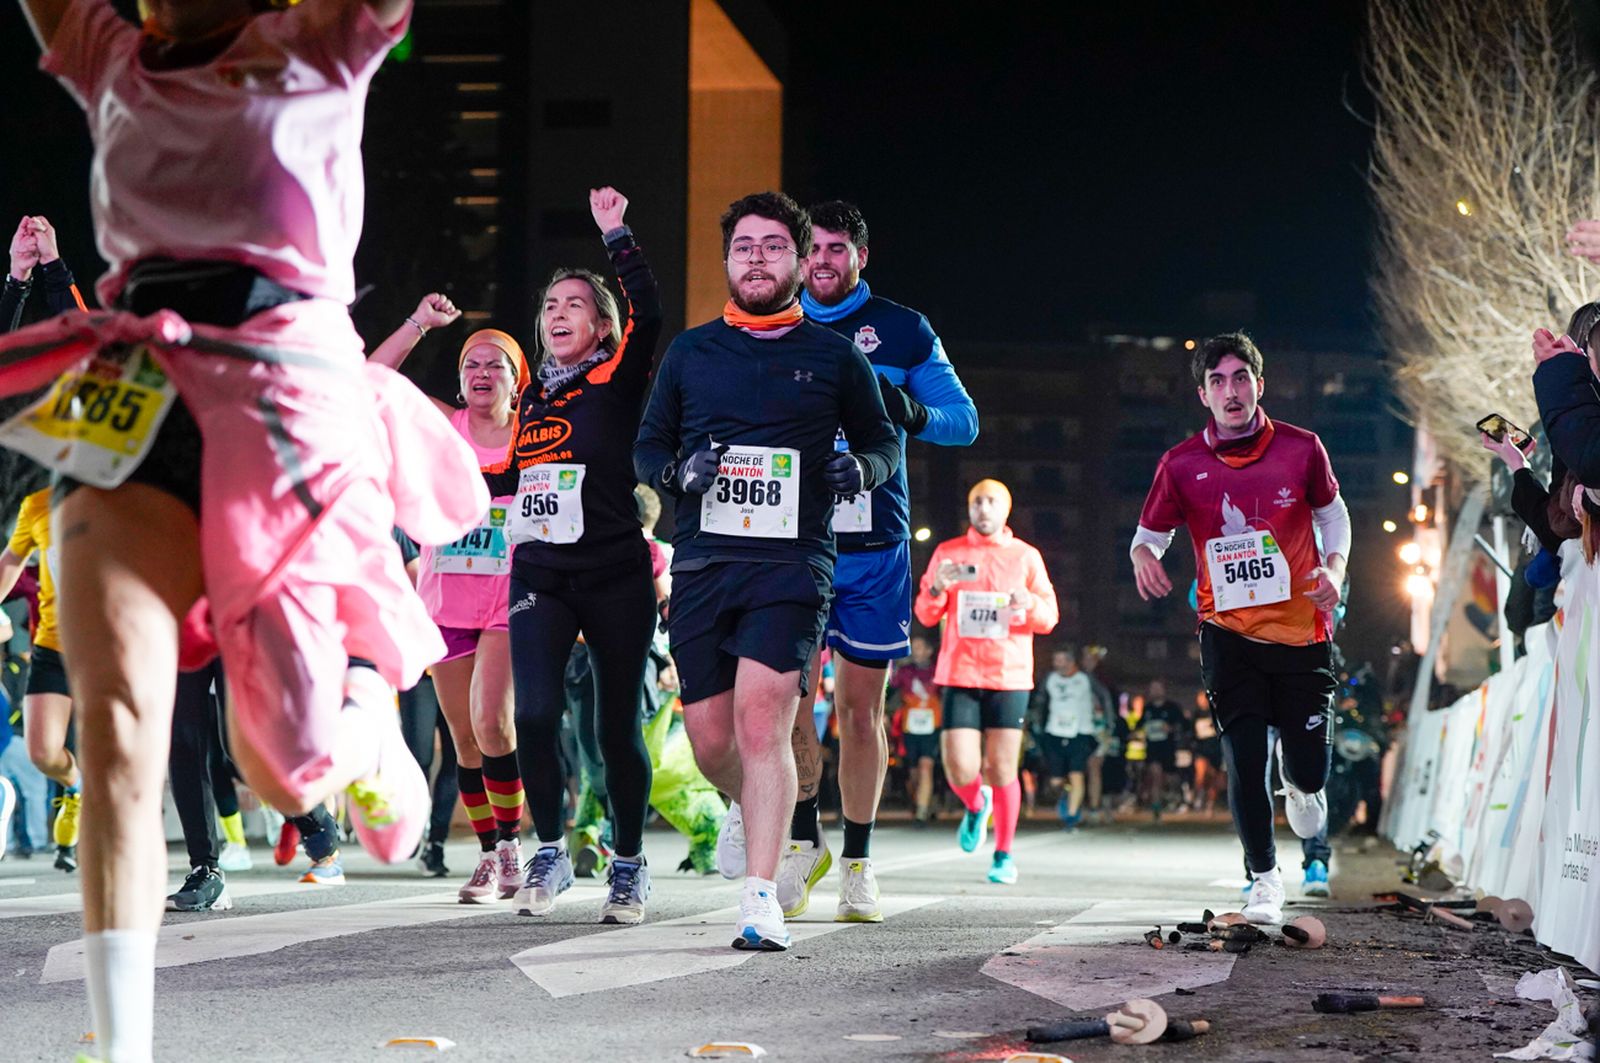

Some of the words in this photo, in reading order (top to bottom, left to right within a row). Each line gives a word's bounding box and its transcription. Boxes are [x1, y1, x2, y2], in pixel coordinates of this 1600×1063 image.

[518, 425, 562, 447] GALBIS
[720, 455, 750, 466] NOCHE
[752, 457, 764, 466] DE
[716, 466, 729, 475] AN
[730, 466, 764, 478] ANTÓN
[716, 476, 782, 507] 3968
[521, 492, 559, 518] 956
[1224, 543, 1246, 552] NOCHE
[1216, 553, 1232, 563] SAN
[1233, 549, 1257, 560] ANTÓN
[1224, 556, 1275, 584] 5465
[970, 609, 997, 622] 4774
